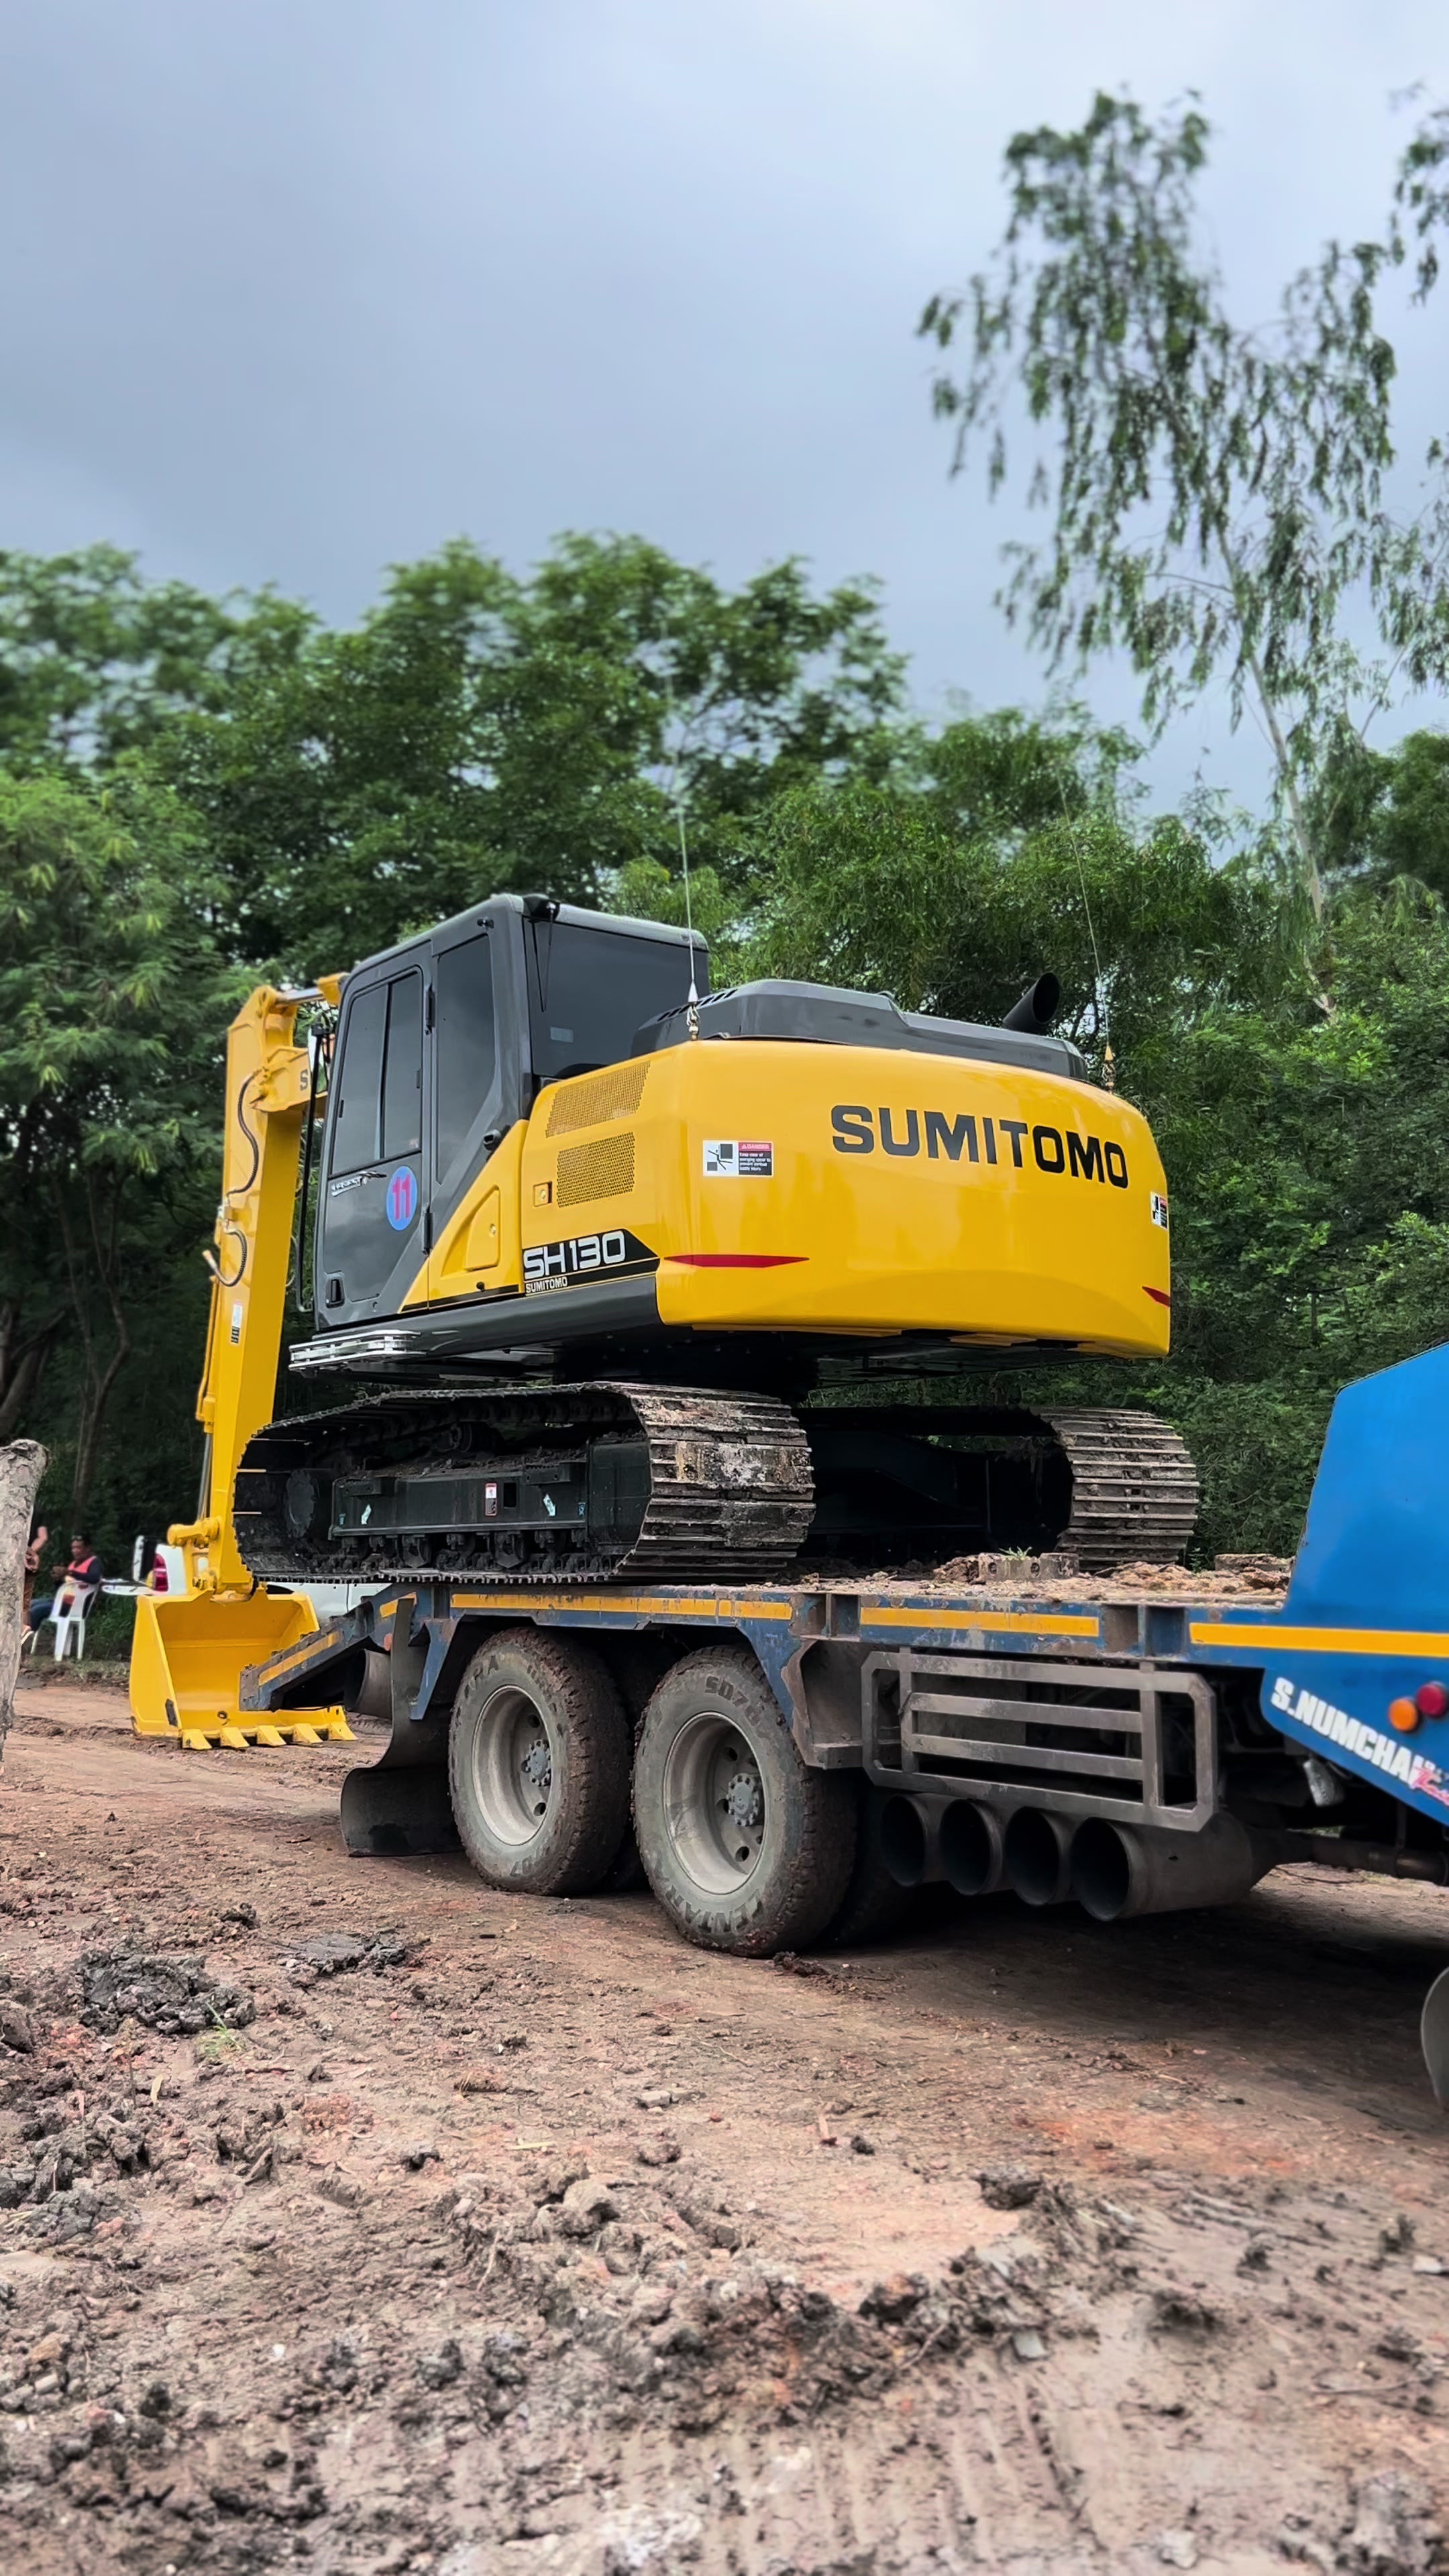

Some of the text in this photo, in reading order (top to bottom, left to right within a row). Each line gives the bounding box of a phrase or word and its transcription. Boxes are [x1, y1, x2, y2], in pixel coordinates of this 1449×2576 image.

[830, 1104, 1128, 1189] SUMITOMO
[391, 1173, 411, 1221] 11
[523, 1230, 626, 1281] SH130
[525, 1276, 568, 1293] SUMITOMO
